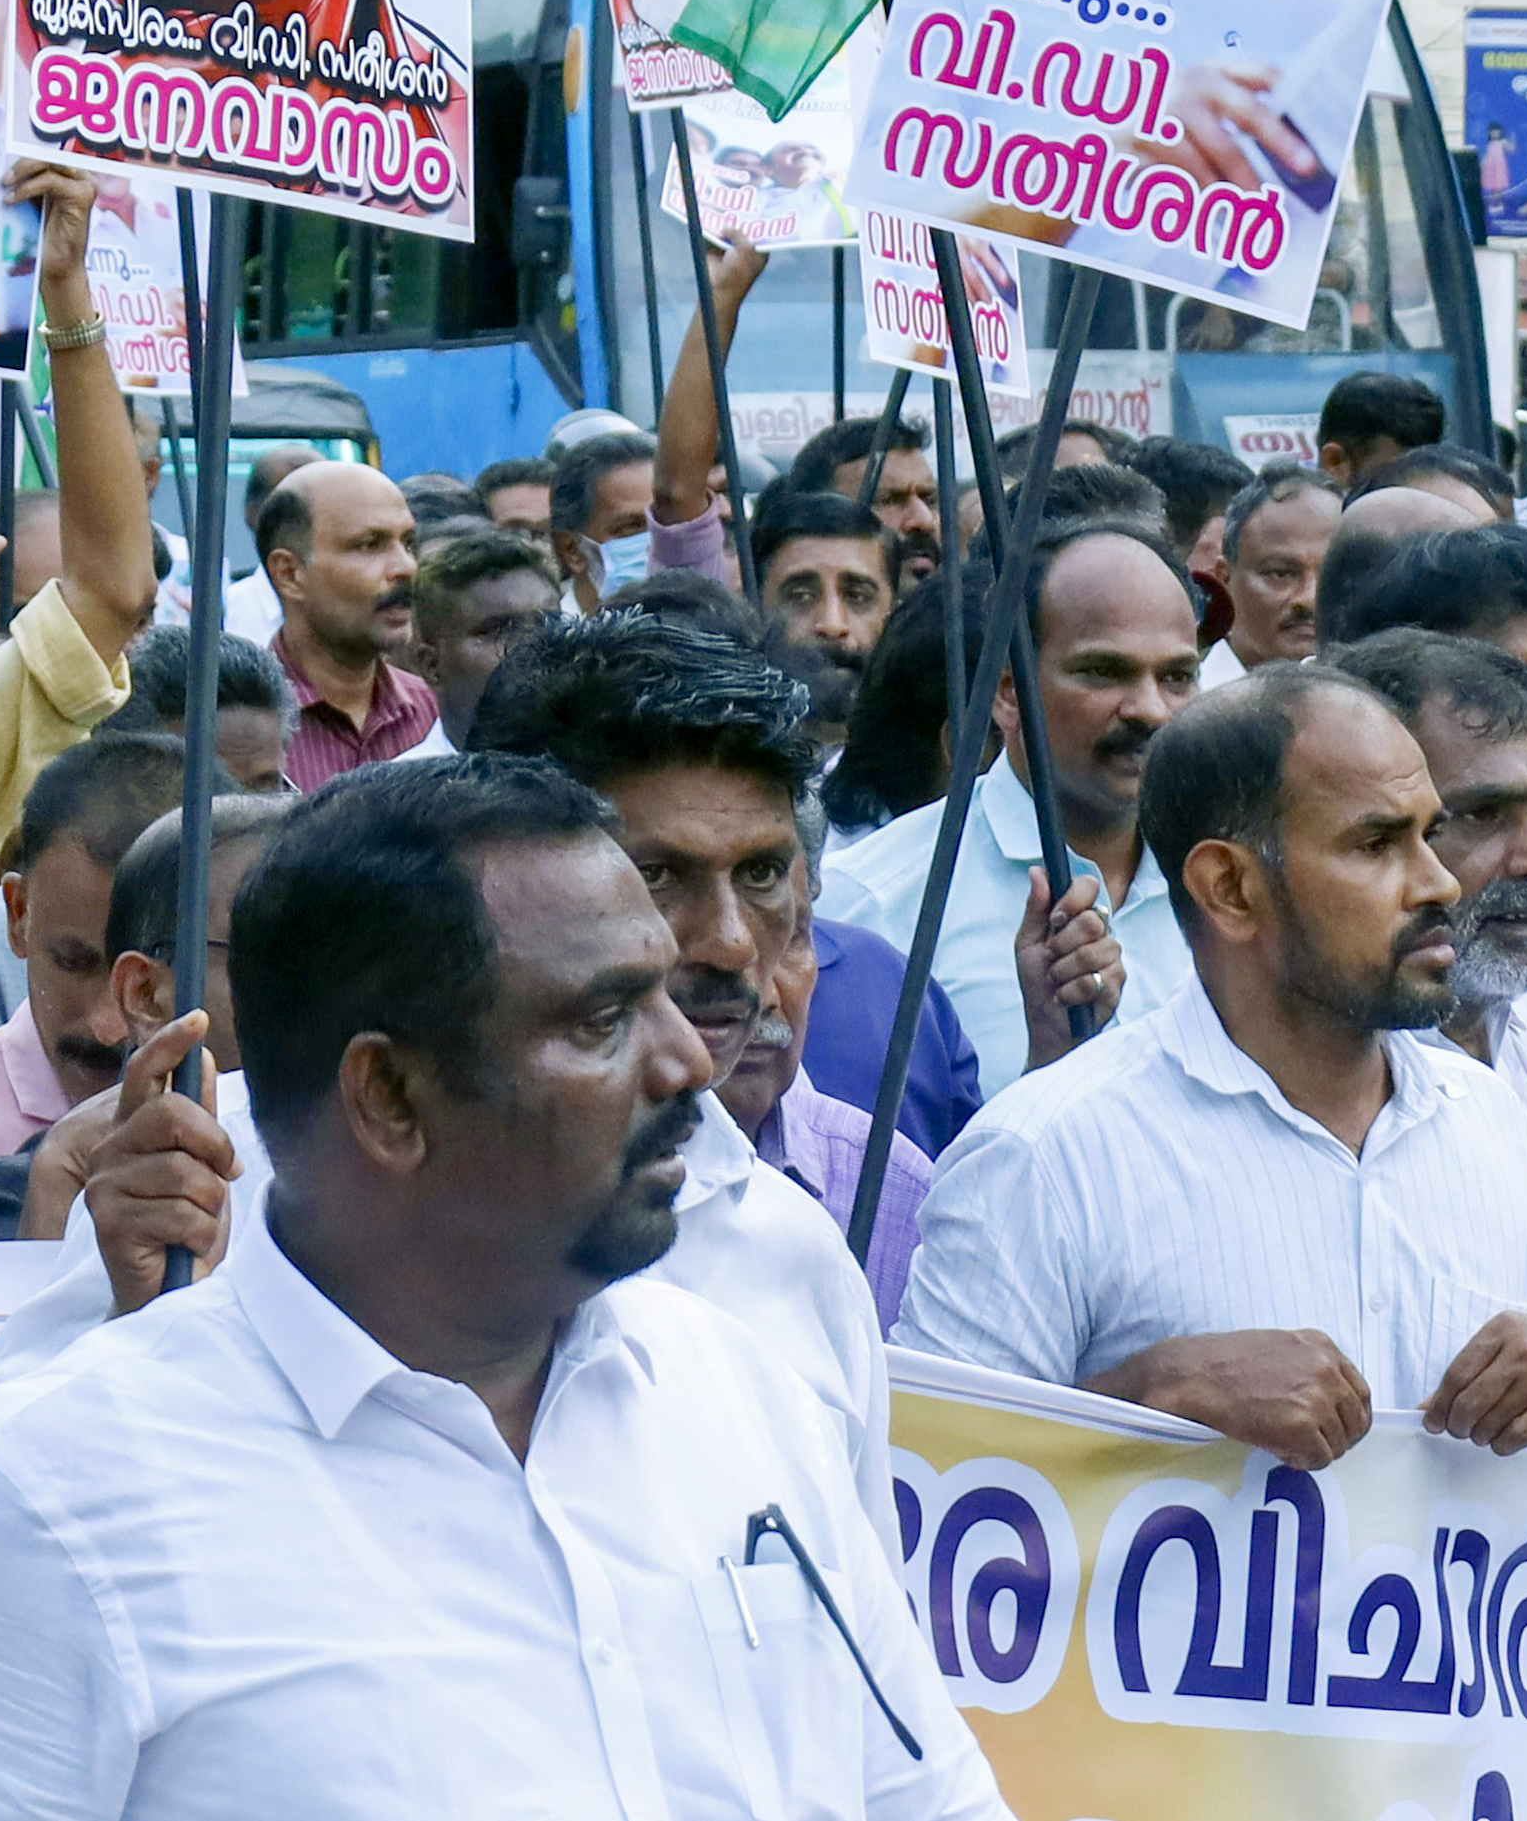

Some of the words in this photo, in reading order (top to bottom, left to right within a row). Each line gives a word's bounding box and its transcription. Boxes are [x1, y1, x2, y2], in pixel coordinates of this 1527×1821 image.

[209, 2, 312, 76] വി.ഡി.
[318, 32, 447, 104] സതീശൻ
[909, 10, 1179, 140] വി.ഡി.
[34, 54, 452, 197] ജനവാസം
[884, 107, 1285, 271] സതീശൻ
